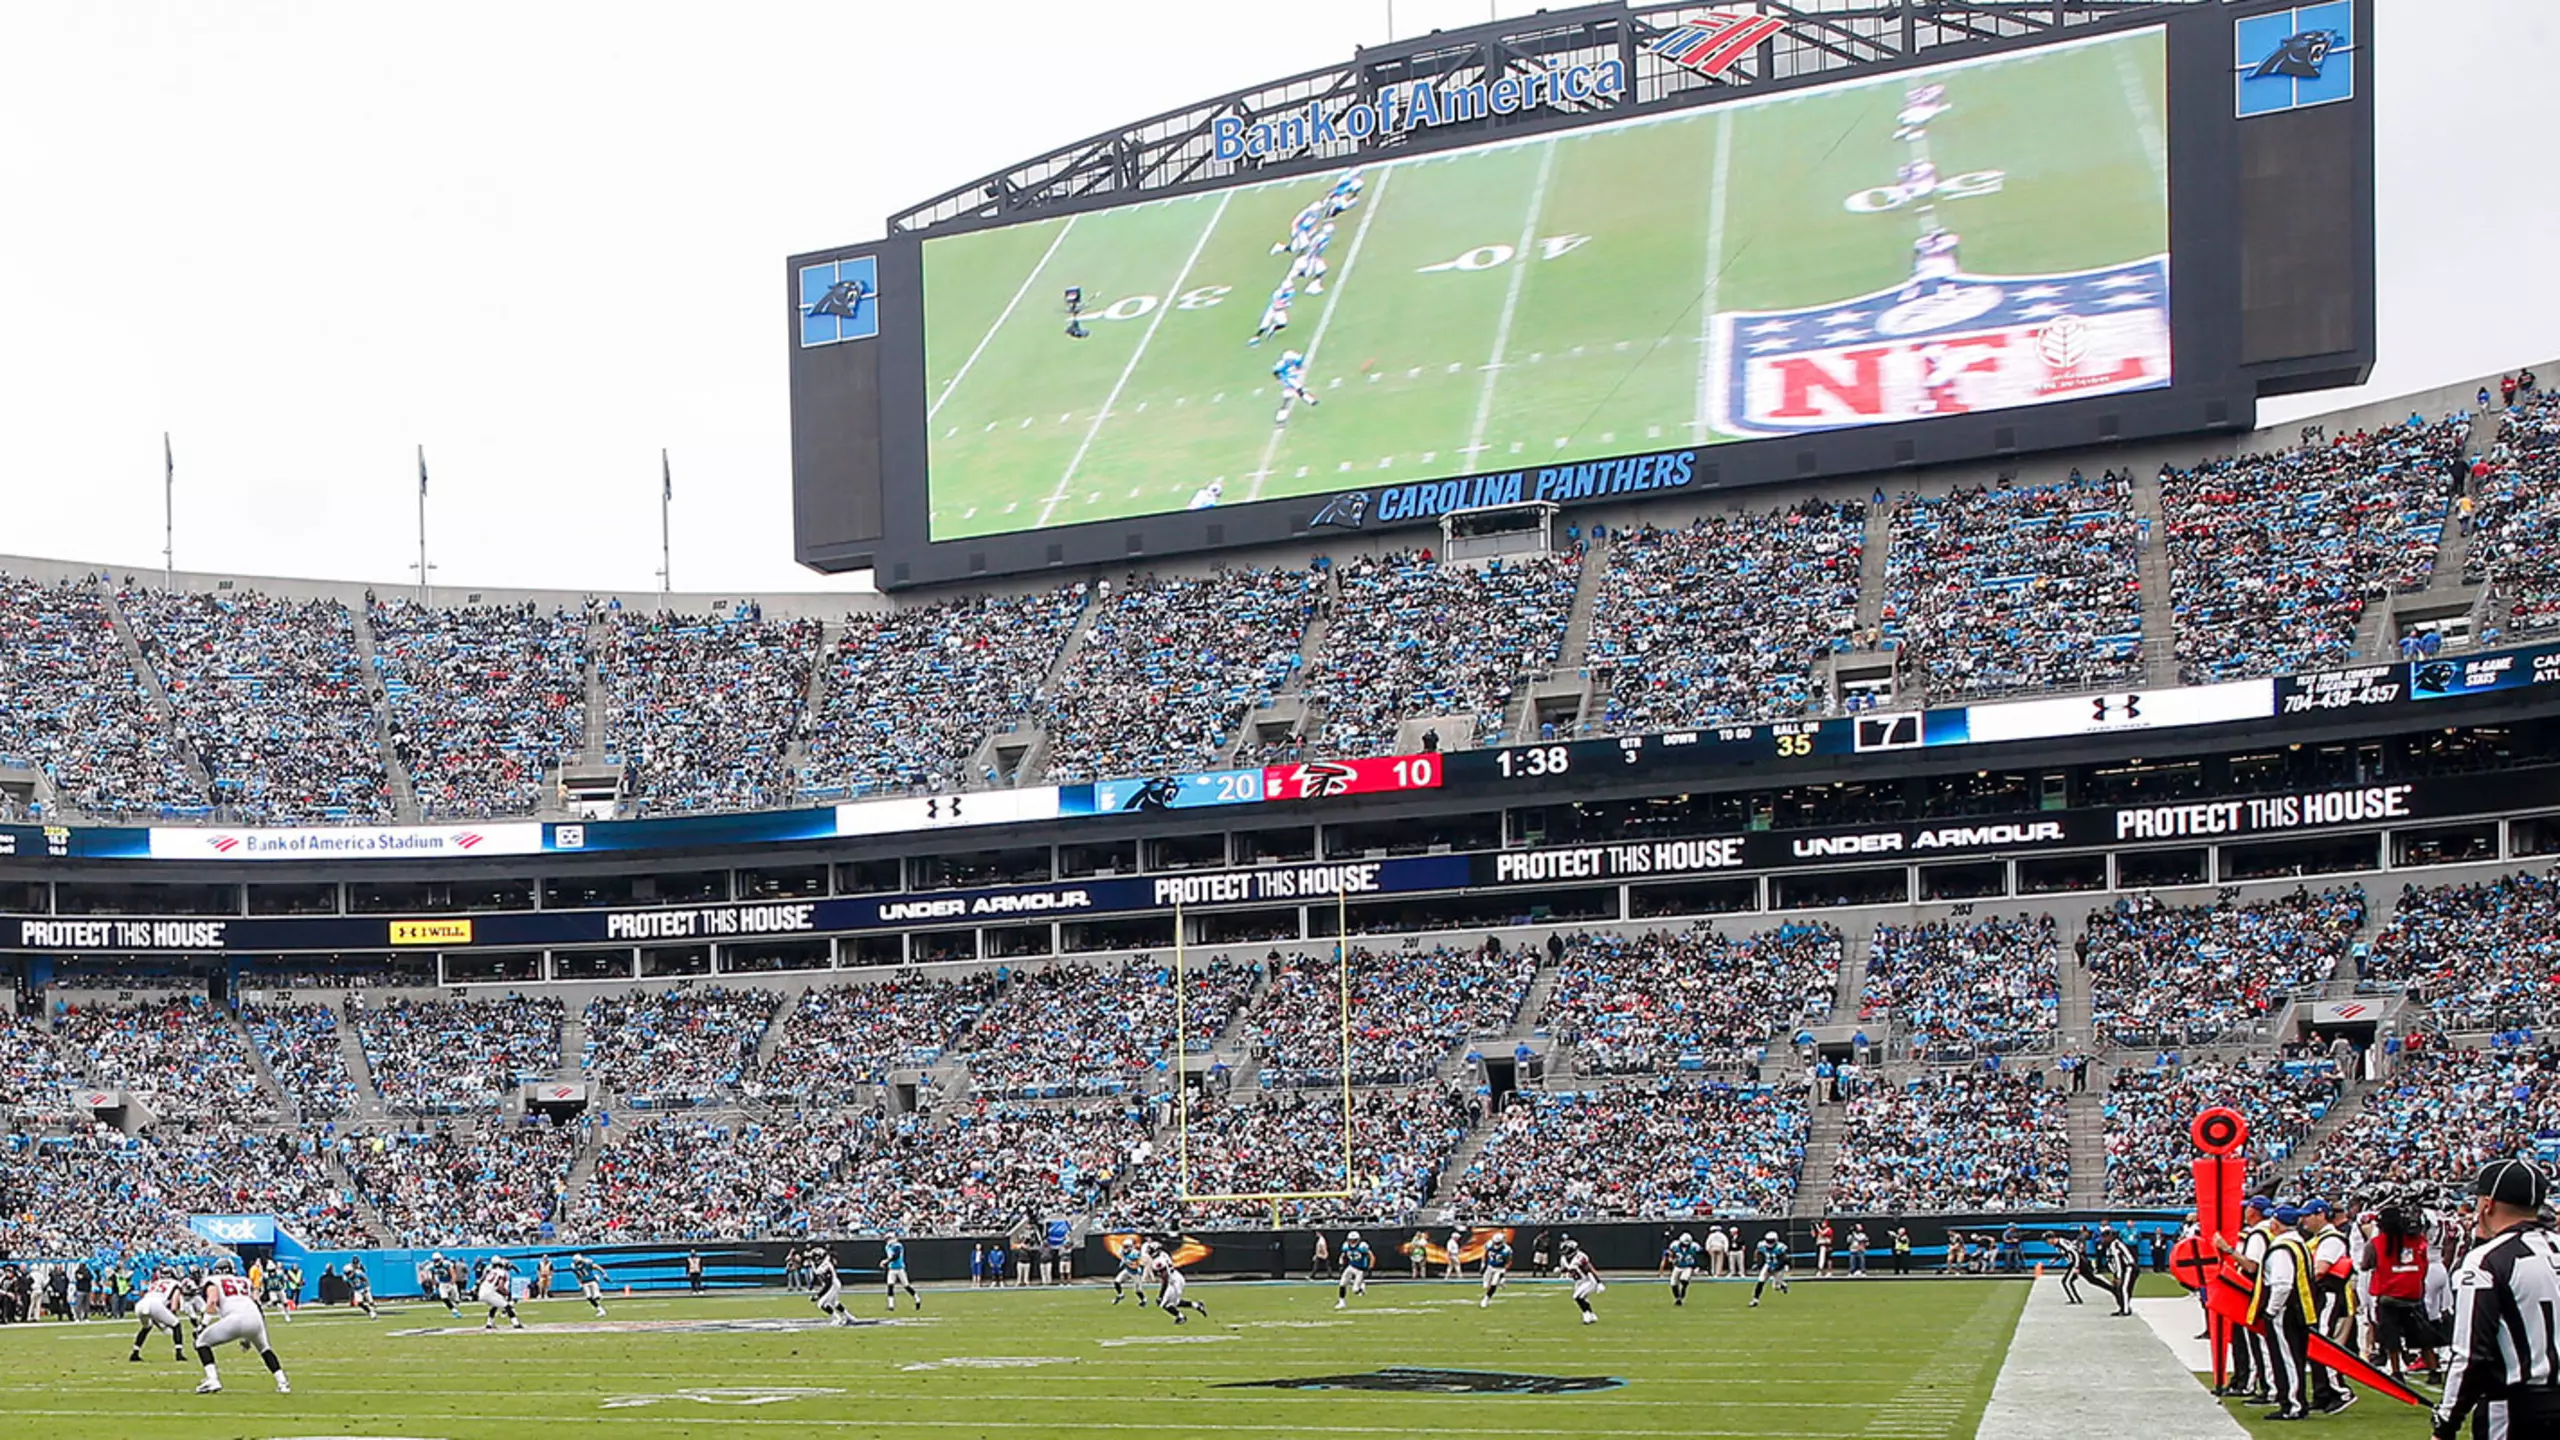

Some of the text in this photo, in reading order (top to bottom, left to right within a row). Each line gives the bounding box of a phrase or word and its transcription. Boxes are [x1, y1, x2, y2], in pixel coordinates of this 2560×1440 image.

[1212, 57, 1627, 162] Bank of America
[1378, 451, 1697, 521] CAROLINA PANTHERS
[2464, 671, 2496, 687] STATS
[2283, 683, 2400, 714] 704-438-4357
[1663, 731, 1697, 746] DOWN
[1718, 727, 1752, 741] TO GO
[1772, 721, 1820, 737] BALL ON
[1876, 718, 1900, 746] 7
[1620, 737, 1642, 749] QTR
[1776, 734, 1812, 757] 35
[1496, 746, 1569, 778] 1:38
[1625, 750, 1637, 764] 3
[1392, 758, 1432, 787] 10
[1216, 774, 1256, 801] 20
[2116, 801, 2243, 839] PROTECT
[2247, 797, 2299, 829] THIS
[247, 833, 444, 851] Bank of America Stadium
[1792, 833, 1903, 857] UNDER
[1497, 848, 1603, 881] PROTECT
[1607, 845, 1651, 874] THIS
[1154, 873, 1252, 904] PROTECT
[1255, 870, 1295, 898] THIS
[879, 899, 965, 920] UNDER
[1951, 904, 1974, 916] 203
[21, 920, 112, 946] PROTECT
[114, 921, 151, 947] THIS
[607, 911, 698, 939] PROTECT
[701, 908, 738, 934] THIS
[1692, 919, 1713, 932] 202
[2461, 1271, 2476, 1286] 2
